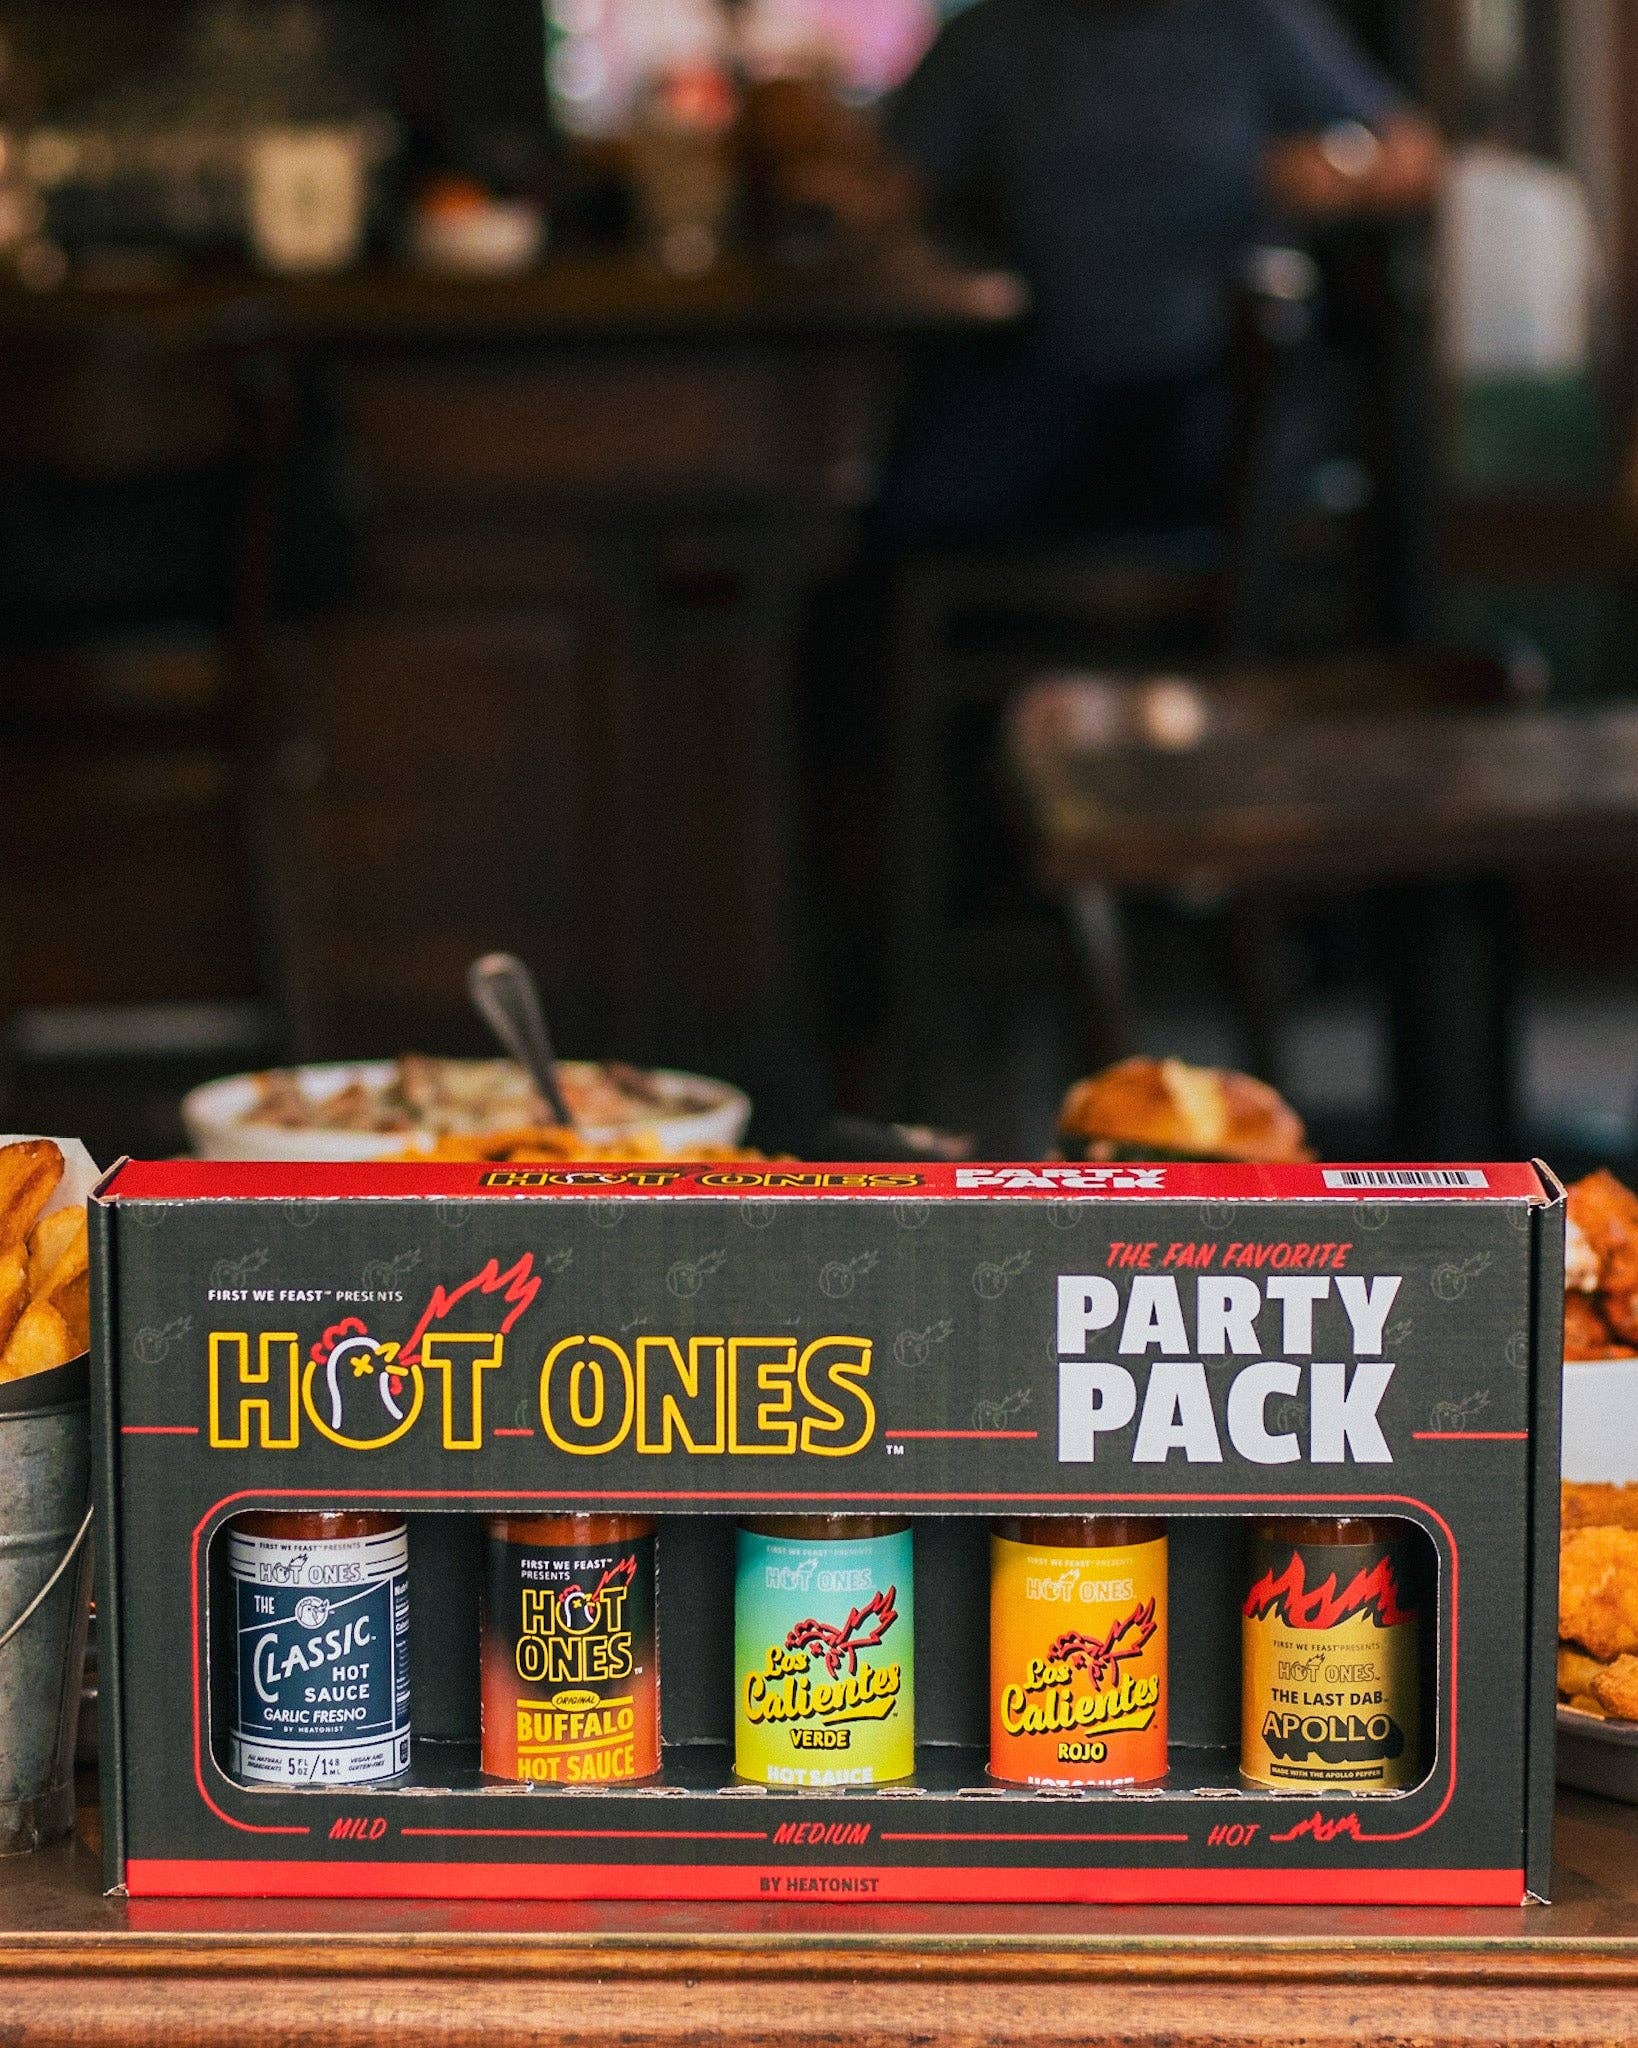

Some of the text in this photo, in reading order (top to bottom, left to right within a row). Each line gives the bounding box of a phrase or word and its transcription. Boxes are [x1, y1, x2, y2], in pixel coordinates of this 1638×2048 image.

[484, 1172, 919, 1187] HOT ONES
[956, 1168, 1168, 1178] PARTY
[956, 1177, 1166, 1189] PACK
[1106, 1242, 1353, 1269] THE FAN FAVORITE
[207, 1289, 248, 1302] FIRST
[252, 1289, 275, 1302] WE
[335, 1290, 404, 1303] PRESENTS
[1057, 1275, 1402, 1355] PARTY
[209, 1330, 876, 1457] HOT ONES
[1058, 1361, 1397, 1465] PACK
[259, 1542, 278, 1550] FIRST
[259, 1562, 361, 1585] HOT ONES
[521, 1559, 550, 1570] FIRST
[552, 1560, 571, 1570] WE
[521, 1570, 571, 1581] PRESENTS
[254, 1595, 275, 1615] THE
[522, 1587, 628, 1635] HOT
[1274, 1640, 1293, 1649] FIRST
[1296, 1643, 1308, 1651] WE
[254, 1615, 370, 1704] CLASSIC
[516, 1632, 634, 1683] ONES
[765, 1645, 808, 1678] Los
[332, 1663, 370, 1682] HOT
[1025, 1658, 1072, 1691] Los
[1279, 1660, 1375, 1683] HOT ONES
[304, 1683, 370, 1703] SAUCE
[556, 1695, 596, 1705] ORIGINAL
[743, 1663, 900, 1723] Calientes
[1002, 1673, 1159, 1735] Calientes
[1272, 1688, 1382, 1706] THE LAST DAB
[263, 1706, 367, 1725] GARLIC FRESNO
[517, 1708, 635, 1743] BUFFALO
[283, 1726, 344, 1734] BY HEATONIST
[1263, 1711, 1391, 1744] APOLLO
[790, 1729, 850, 1750] VERDE
[1057, 1742, 1107, 1761] ROJO
[518, 1744, 636, 1783] HOT SAUCE
[767, 1765, 873, 1787] HOT SAUCE
[328, 1817, 388, 1840] MILD
[772, 1822, 871, 1845] MEDIUM
[1207, 1824, 1260, 1847] HOT
[760, 1877, 879, 1892] BY HEATONIST
